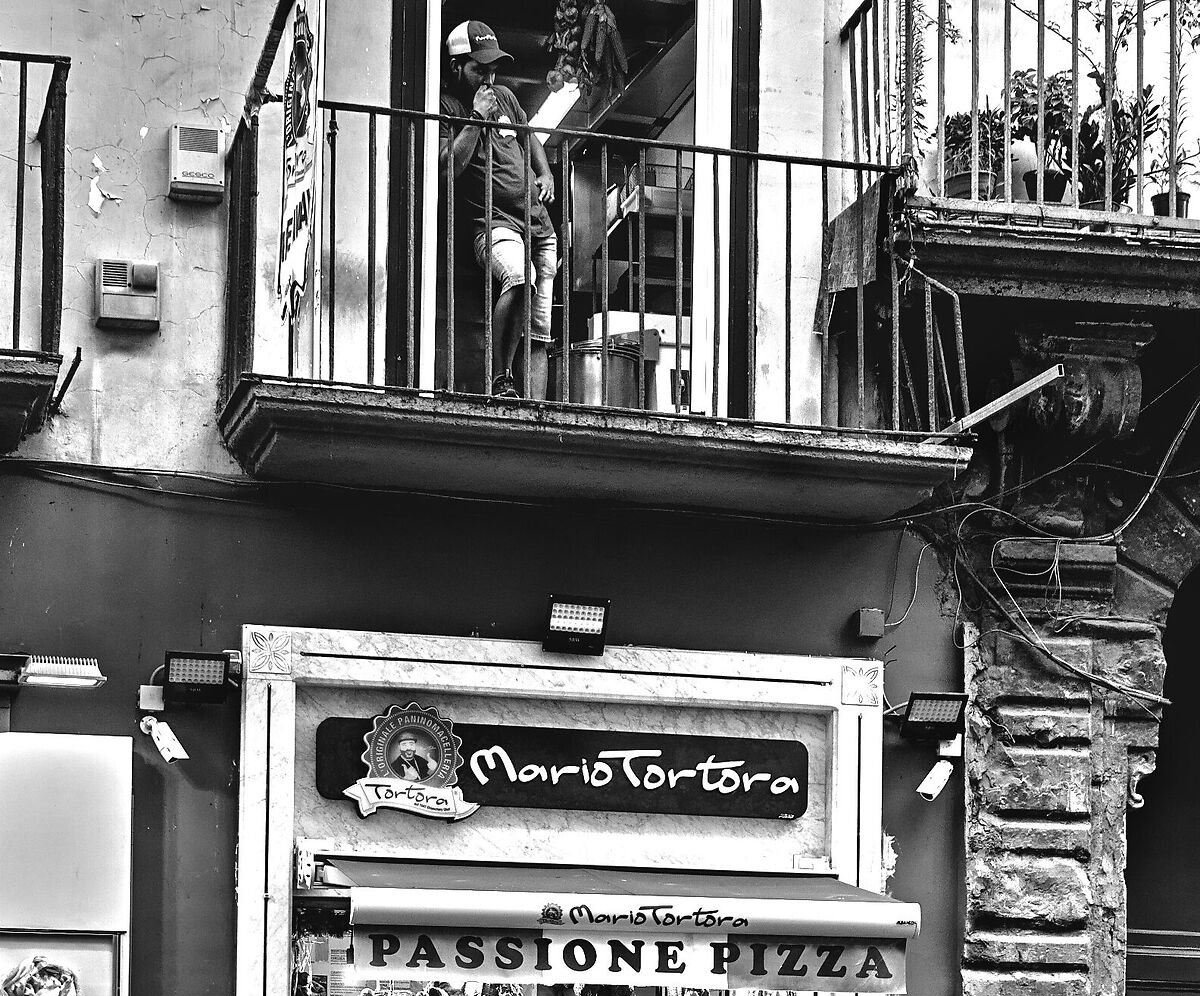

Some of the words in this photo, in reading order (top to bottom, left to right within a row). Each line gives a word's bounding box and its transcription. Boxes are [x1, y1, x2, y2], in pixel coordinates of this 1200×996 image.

[398, 715, 452, 779] PANINOMACELLERIA
[365, 785, 448, 806] Tortora
[368, 934, 686, 974] PASSIONE
[710, 942, 893, 978] PIZZA
